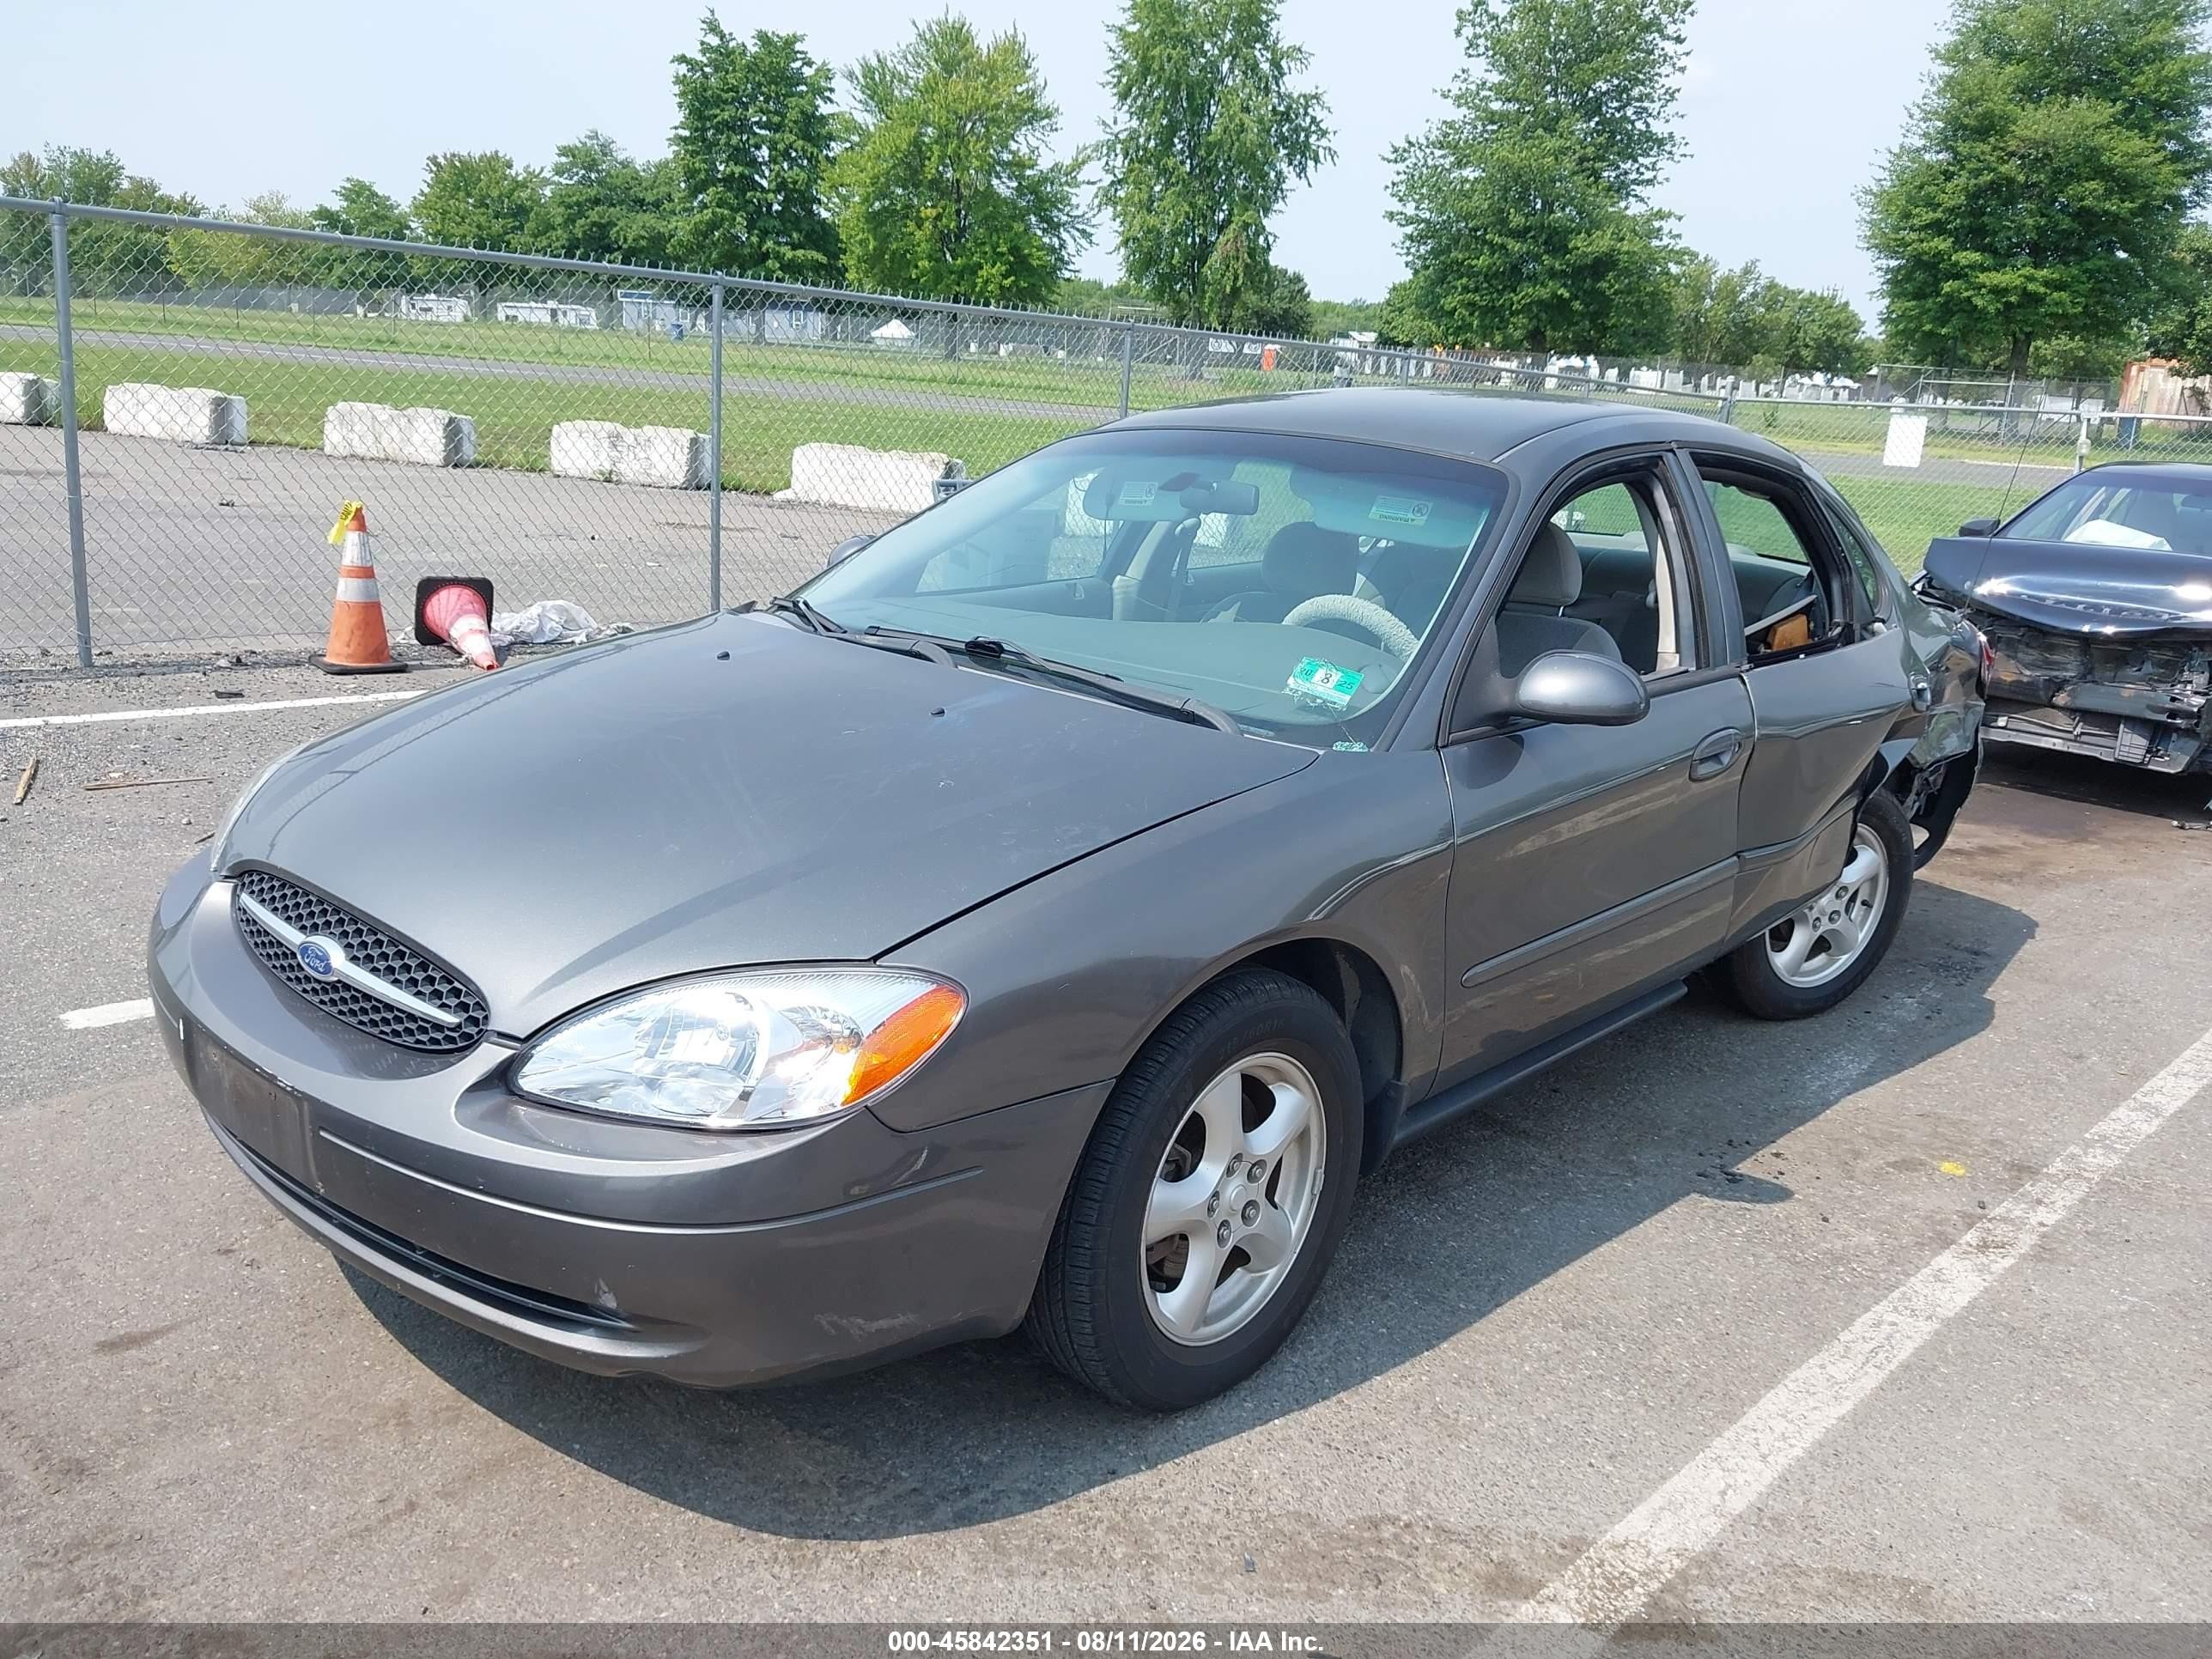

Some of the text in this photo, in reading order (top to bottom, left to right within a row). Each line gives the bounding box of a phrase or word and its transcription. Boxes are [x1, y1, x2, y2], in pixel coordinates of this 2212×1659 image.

[1322, 672, 1333, 684] 8
[1340, 680, 1354, 690] 25
[304, 946, 331, 972] Ford
